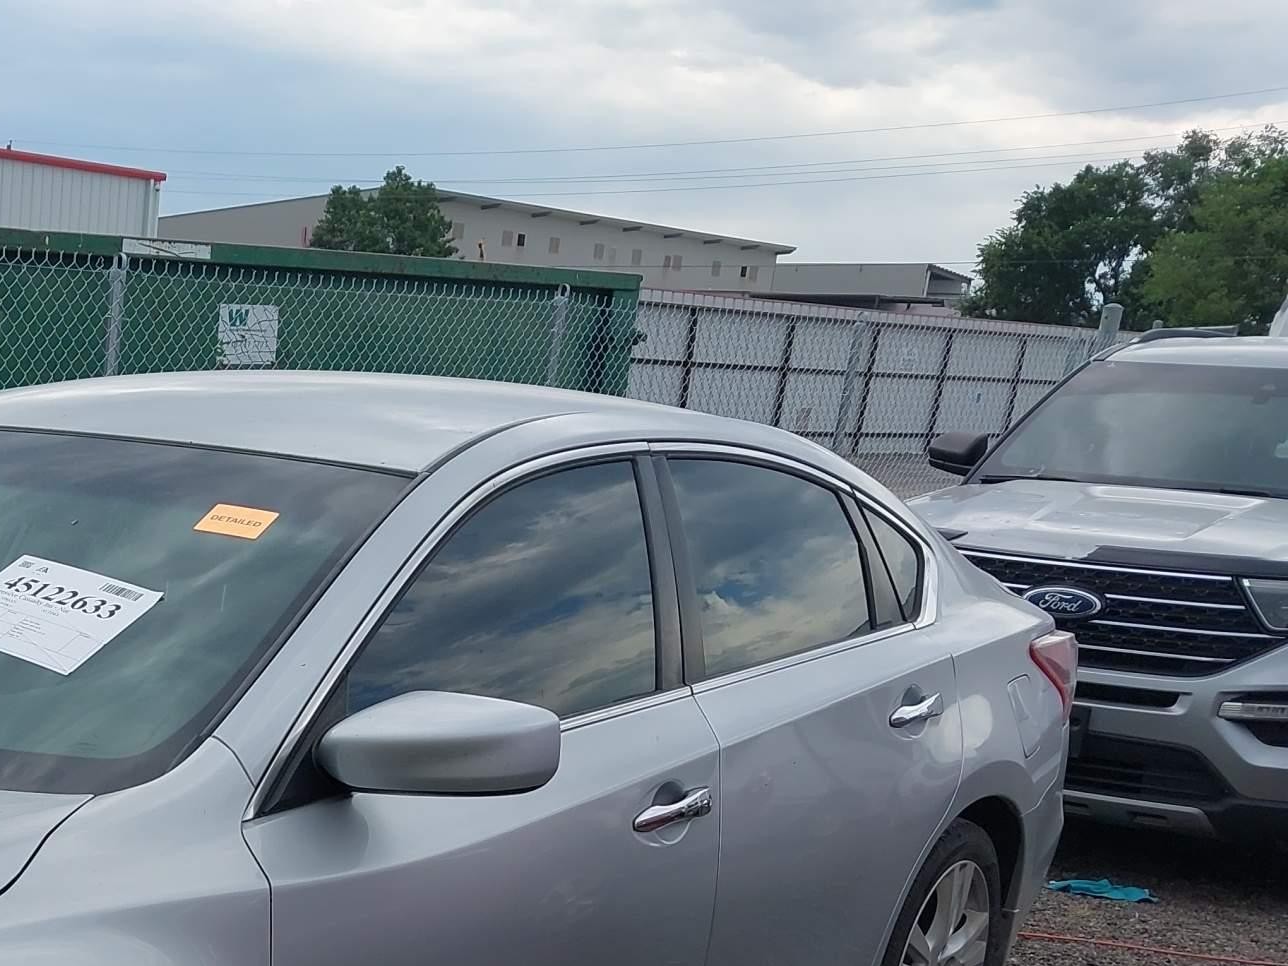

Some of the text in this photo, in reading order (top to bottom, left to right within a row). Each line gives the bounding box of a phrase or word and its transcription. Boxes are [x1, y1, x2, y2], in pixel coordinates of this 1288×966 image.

[210, 514, 262, 528] DETAILED
[3, 576, 122, 620] 45122633
[1038, 592, 1083, 612] Ford
